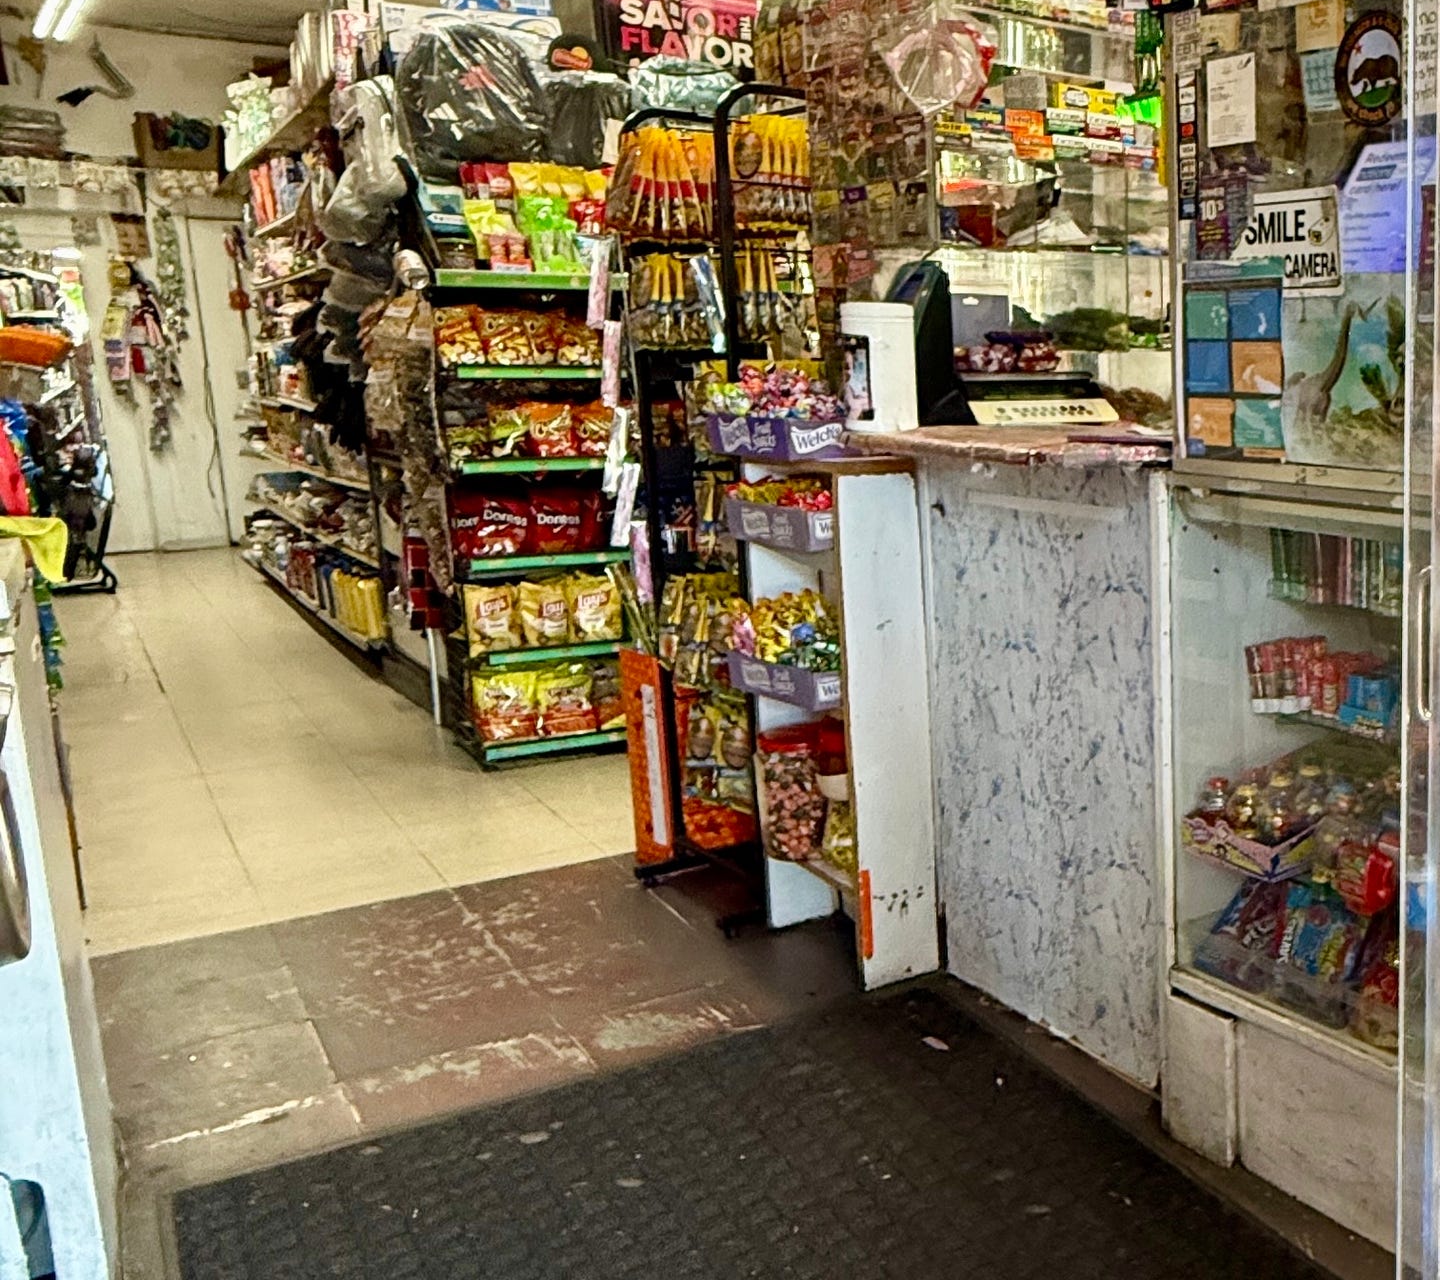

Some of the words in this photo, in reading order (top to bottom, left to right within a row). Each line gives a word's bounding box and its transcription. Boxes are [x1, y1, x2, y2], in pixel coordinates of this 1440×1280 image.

[621, 26, 754, 68] FLAVOR
[1244, 208, 1306, 246] SMILE
[1285, 252, 1338, 279] CAMERA
[795, 423, 841, 450] Welch's
[536, 512, 580, 525] Doritos
